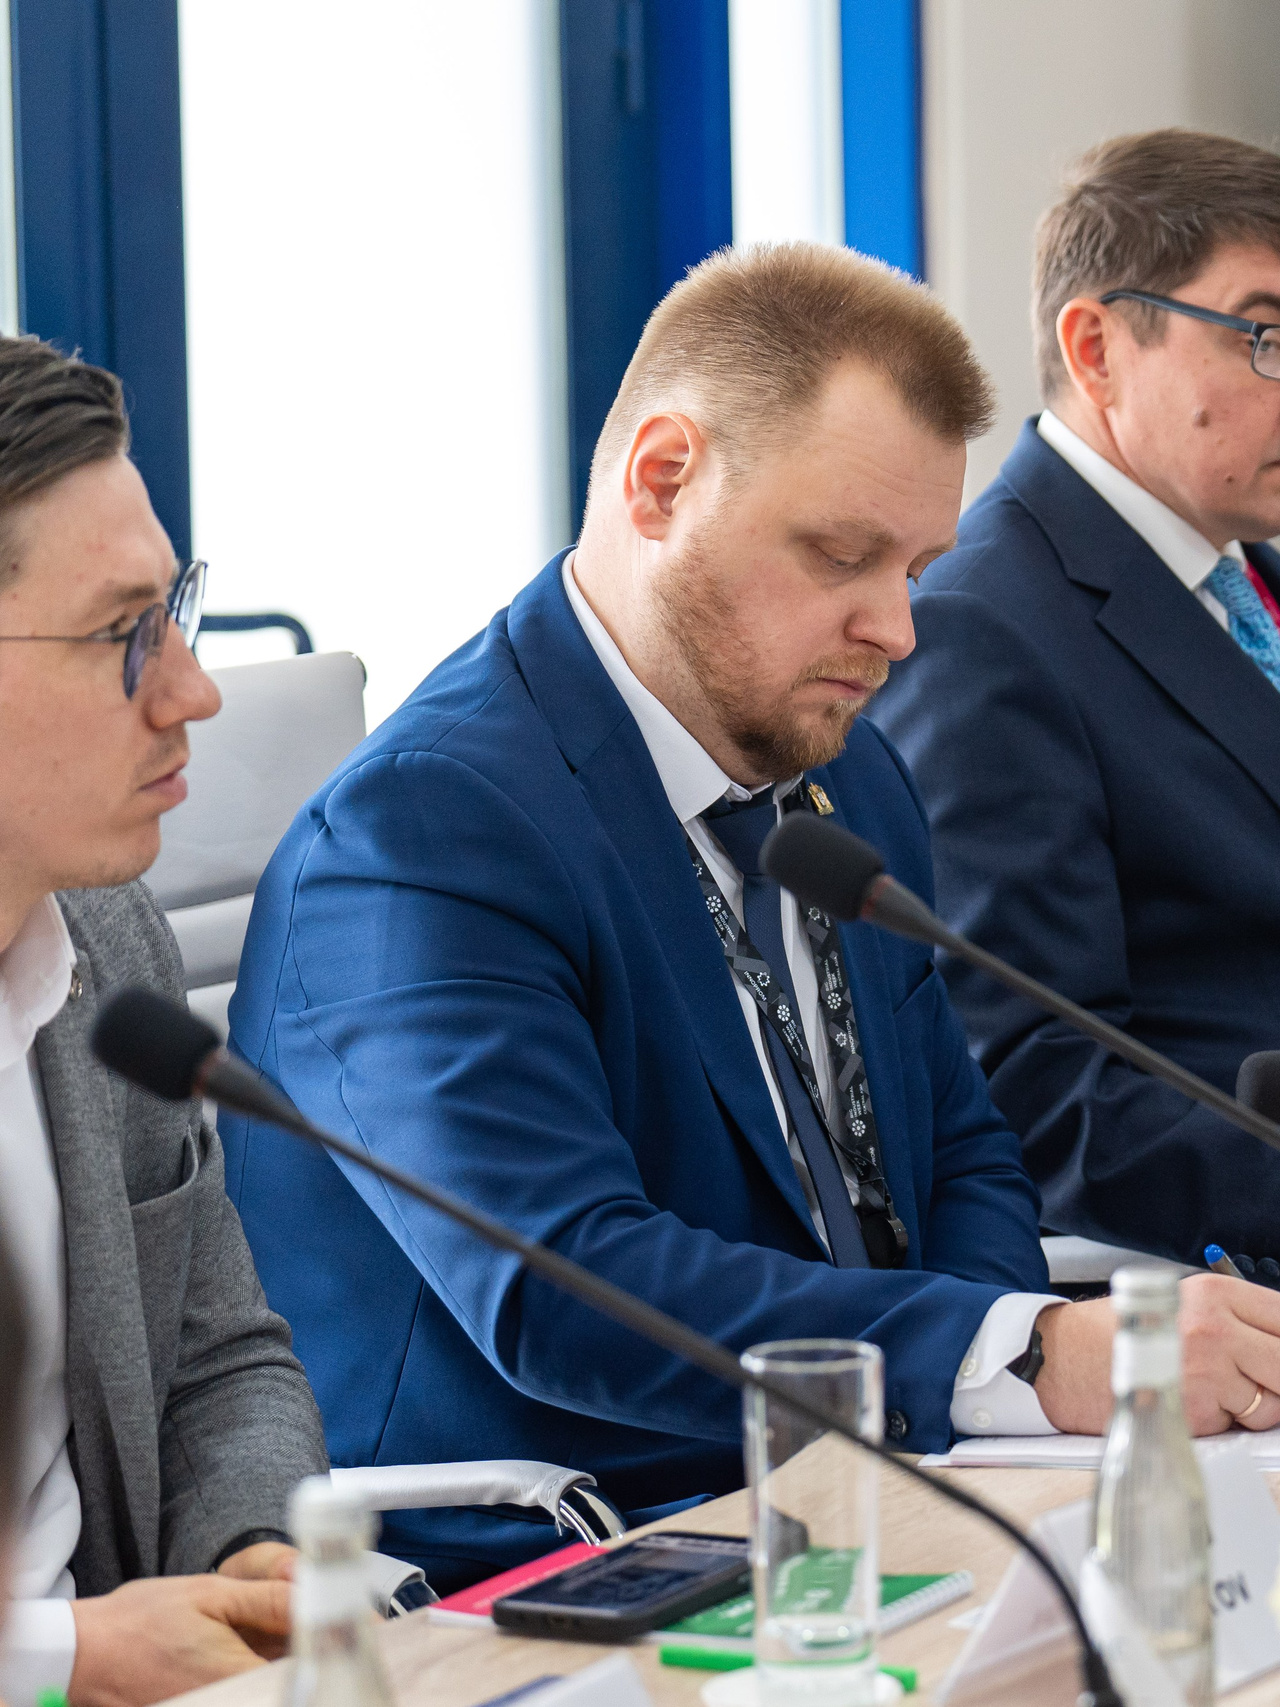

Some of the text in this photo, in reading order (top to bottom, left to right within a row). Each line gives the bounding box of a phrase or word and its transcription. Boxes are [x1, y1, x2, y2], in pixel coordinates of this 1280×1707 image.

[714, 916, 724, 931] WEEK
[718, 912, 736, 942] INDUSTRIAL
[721, 910, 729, 920] BIG
[744, 970, 767, 1002] INNOPROM
[824, 959, 833, 991] INDUSTRIAL
[785, 1025, 795, 1040] WEEK
[788, 1021, 804, 1051] INDUSTRIAL
[846, 1020, 856, 1055] INNOPROM
[849, 1085, 858, 1118] INDUSTRIAL
